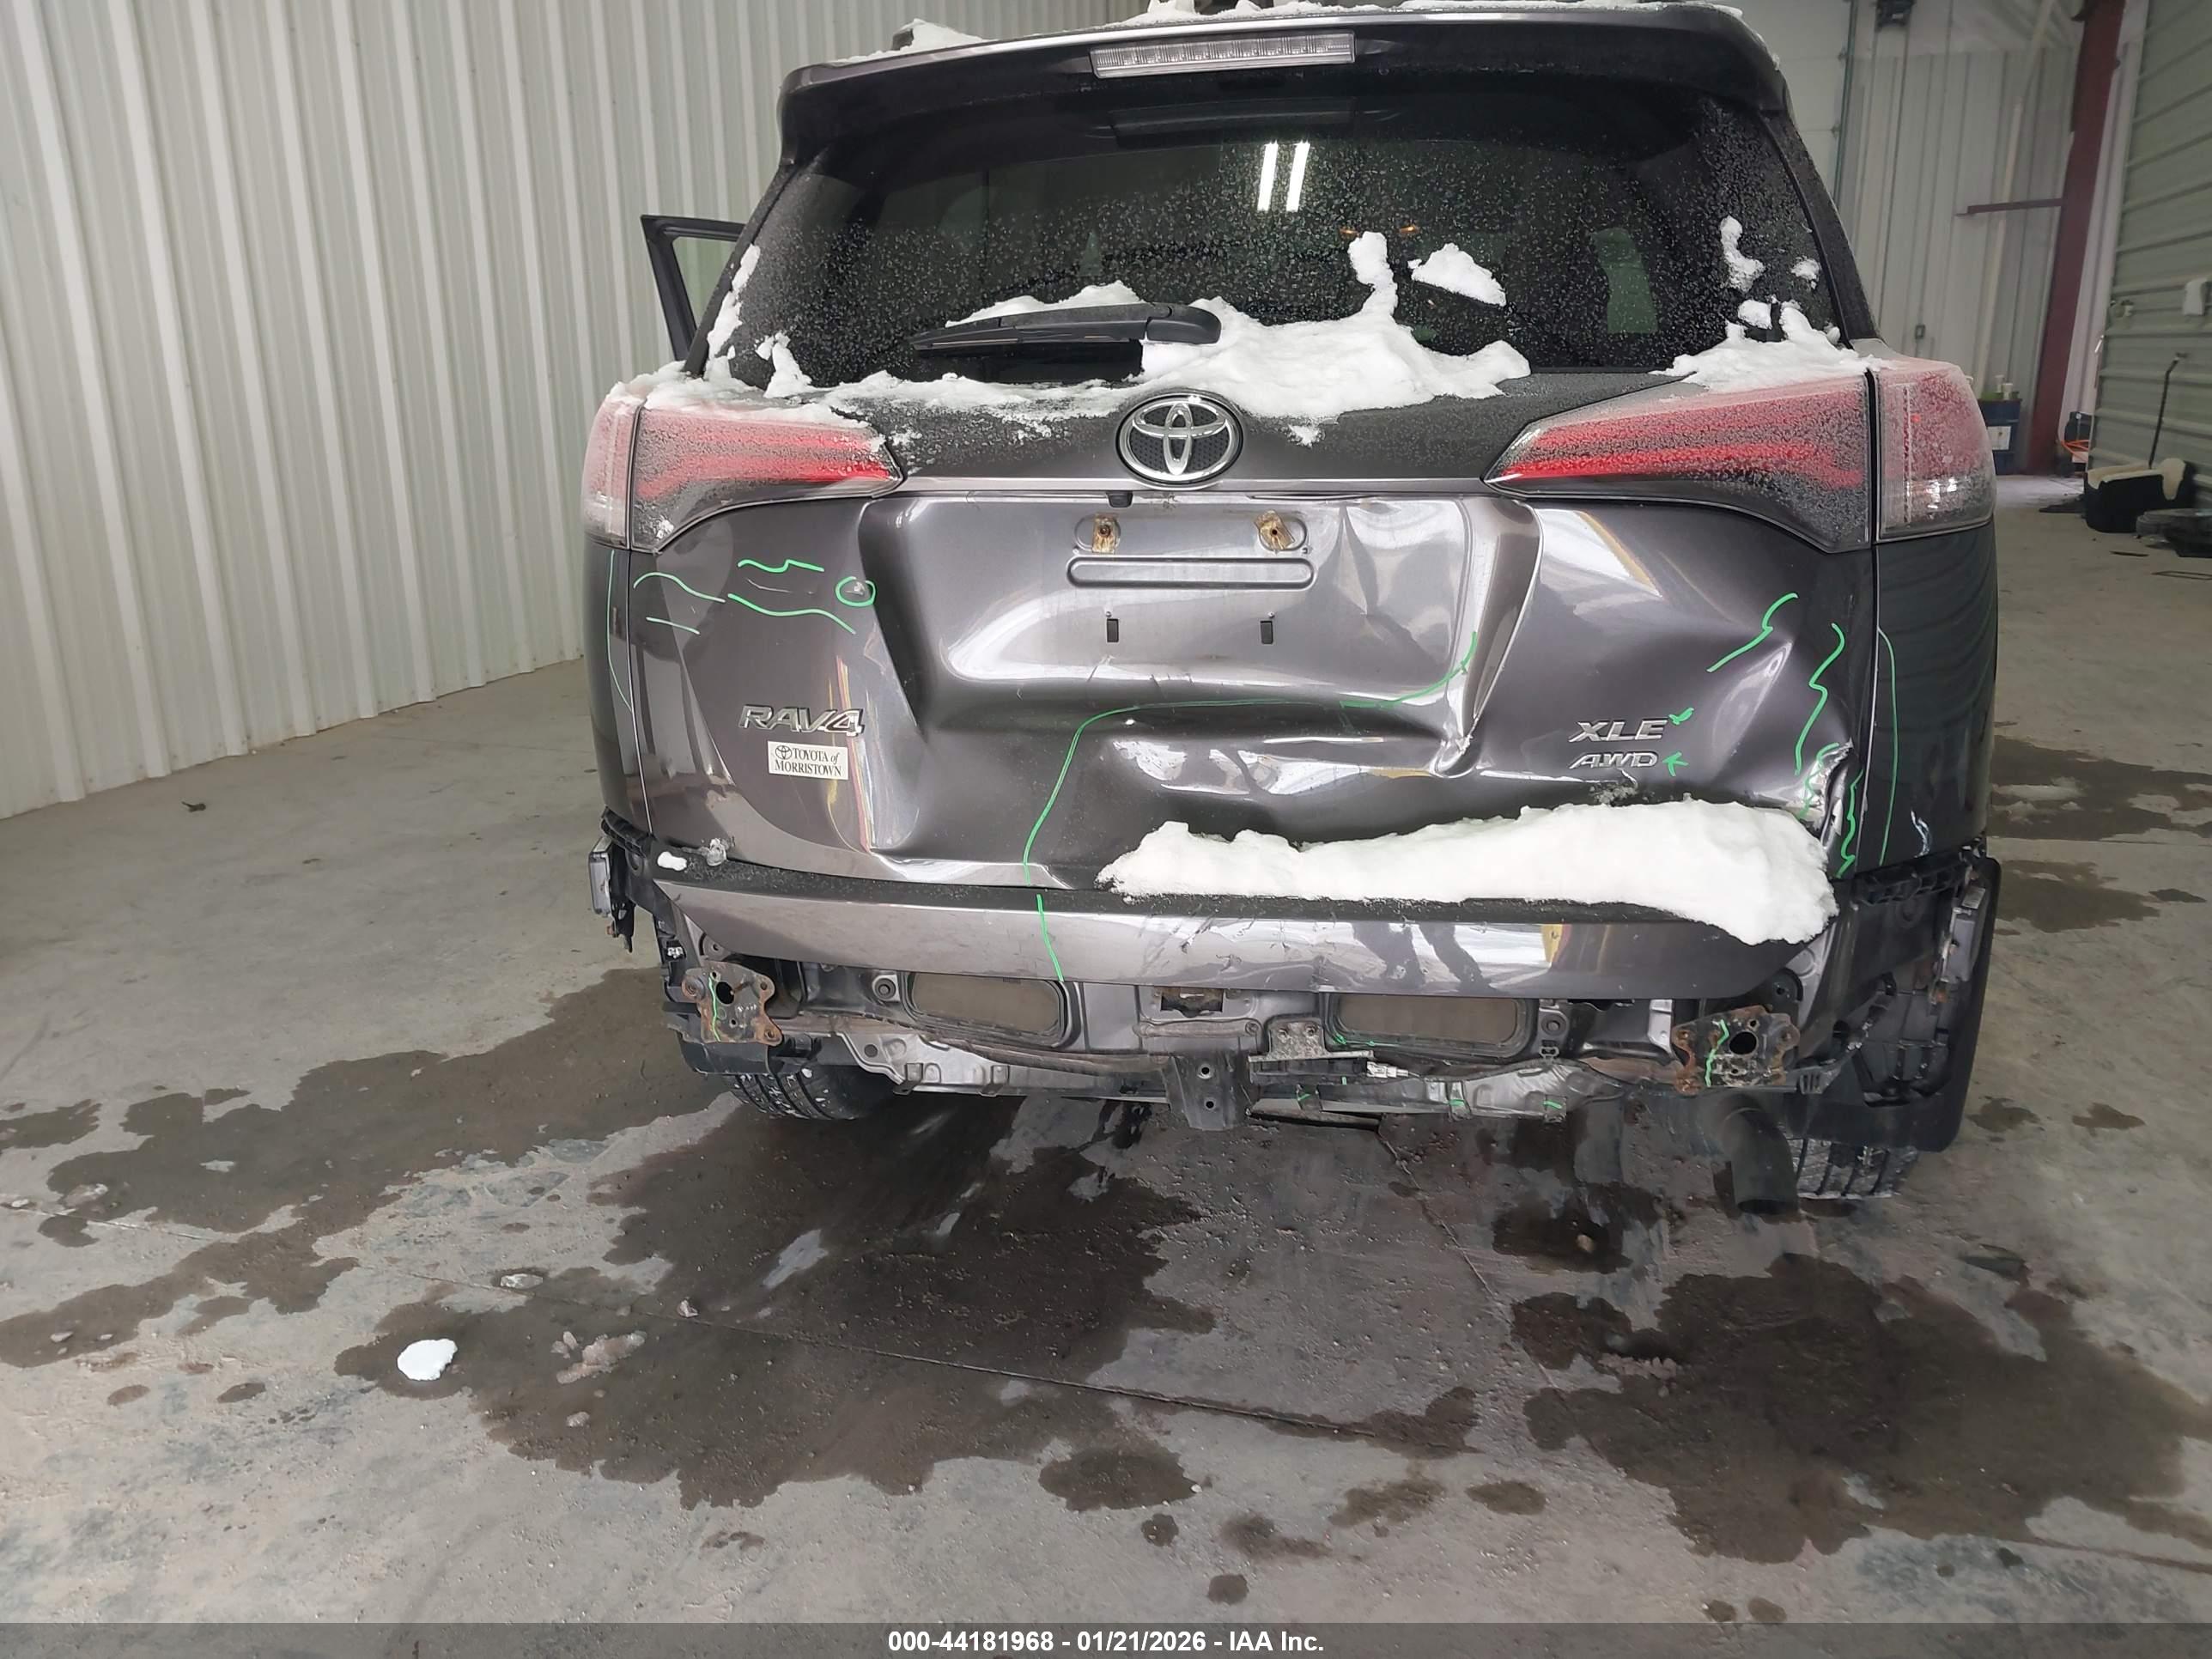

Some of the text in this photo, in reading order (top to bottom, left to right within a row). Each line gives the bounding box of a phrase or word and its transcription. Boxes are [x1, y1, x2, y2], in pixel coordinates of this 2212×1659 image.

[738, 704, 865, 737] RAV4
[1568, 717, 1668, 743] XLE
[792, 748, 841, 764] TOYOTA of
[1569, 750, 1659, 769] AWD
[775, 759, 842, 776] MORRISTOWN
